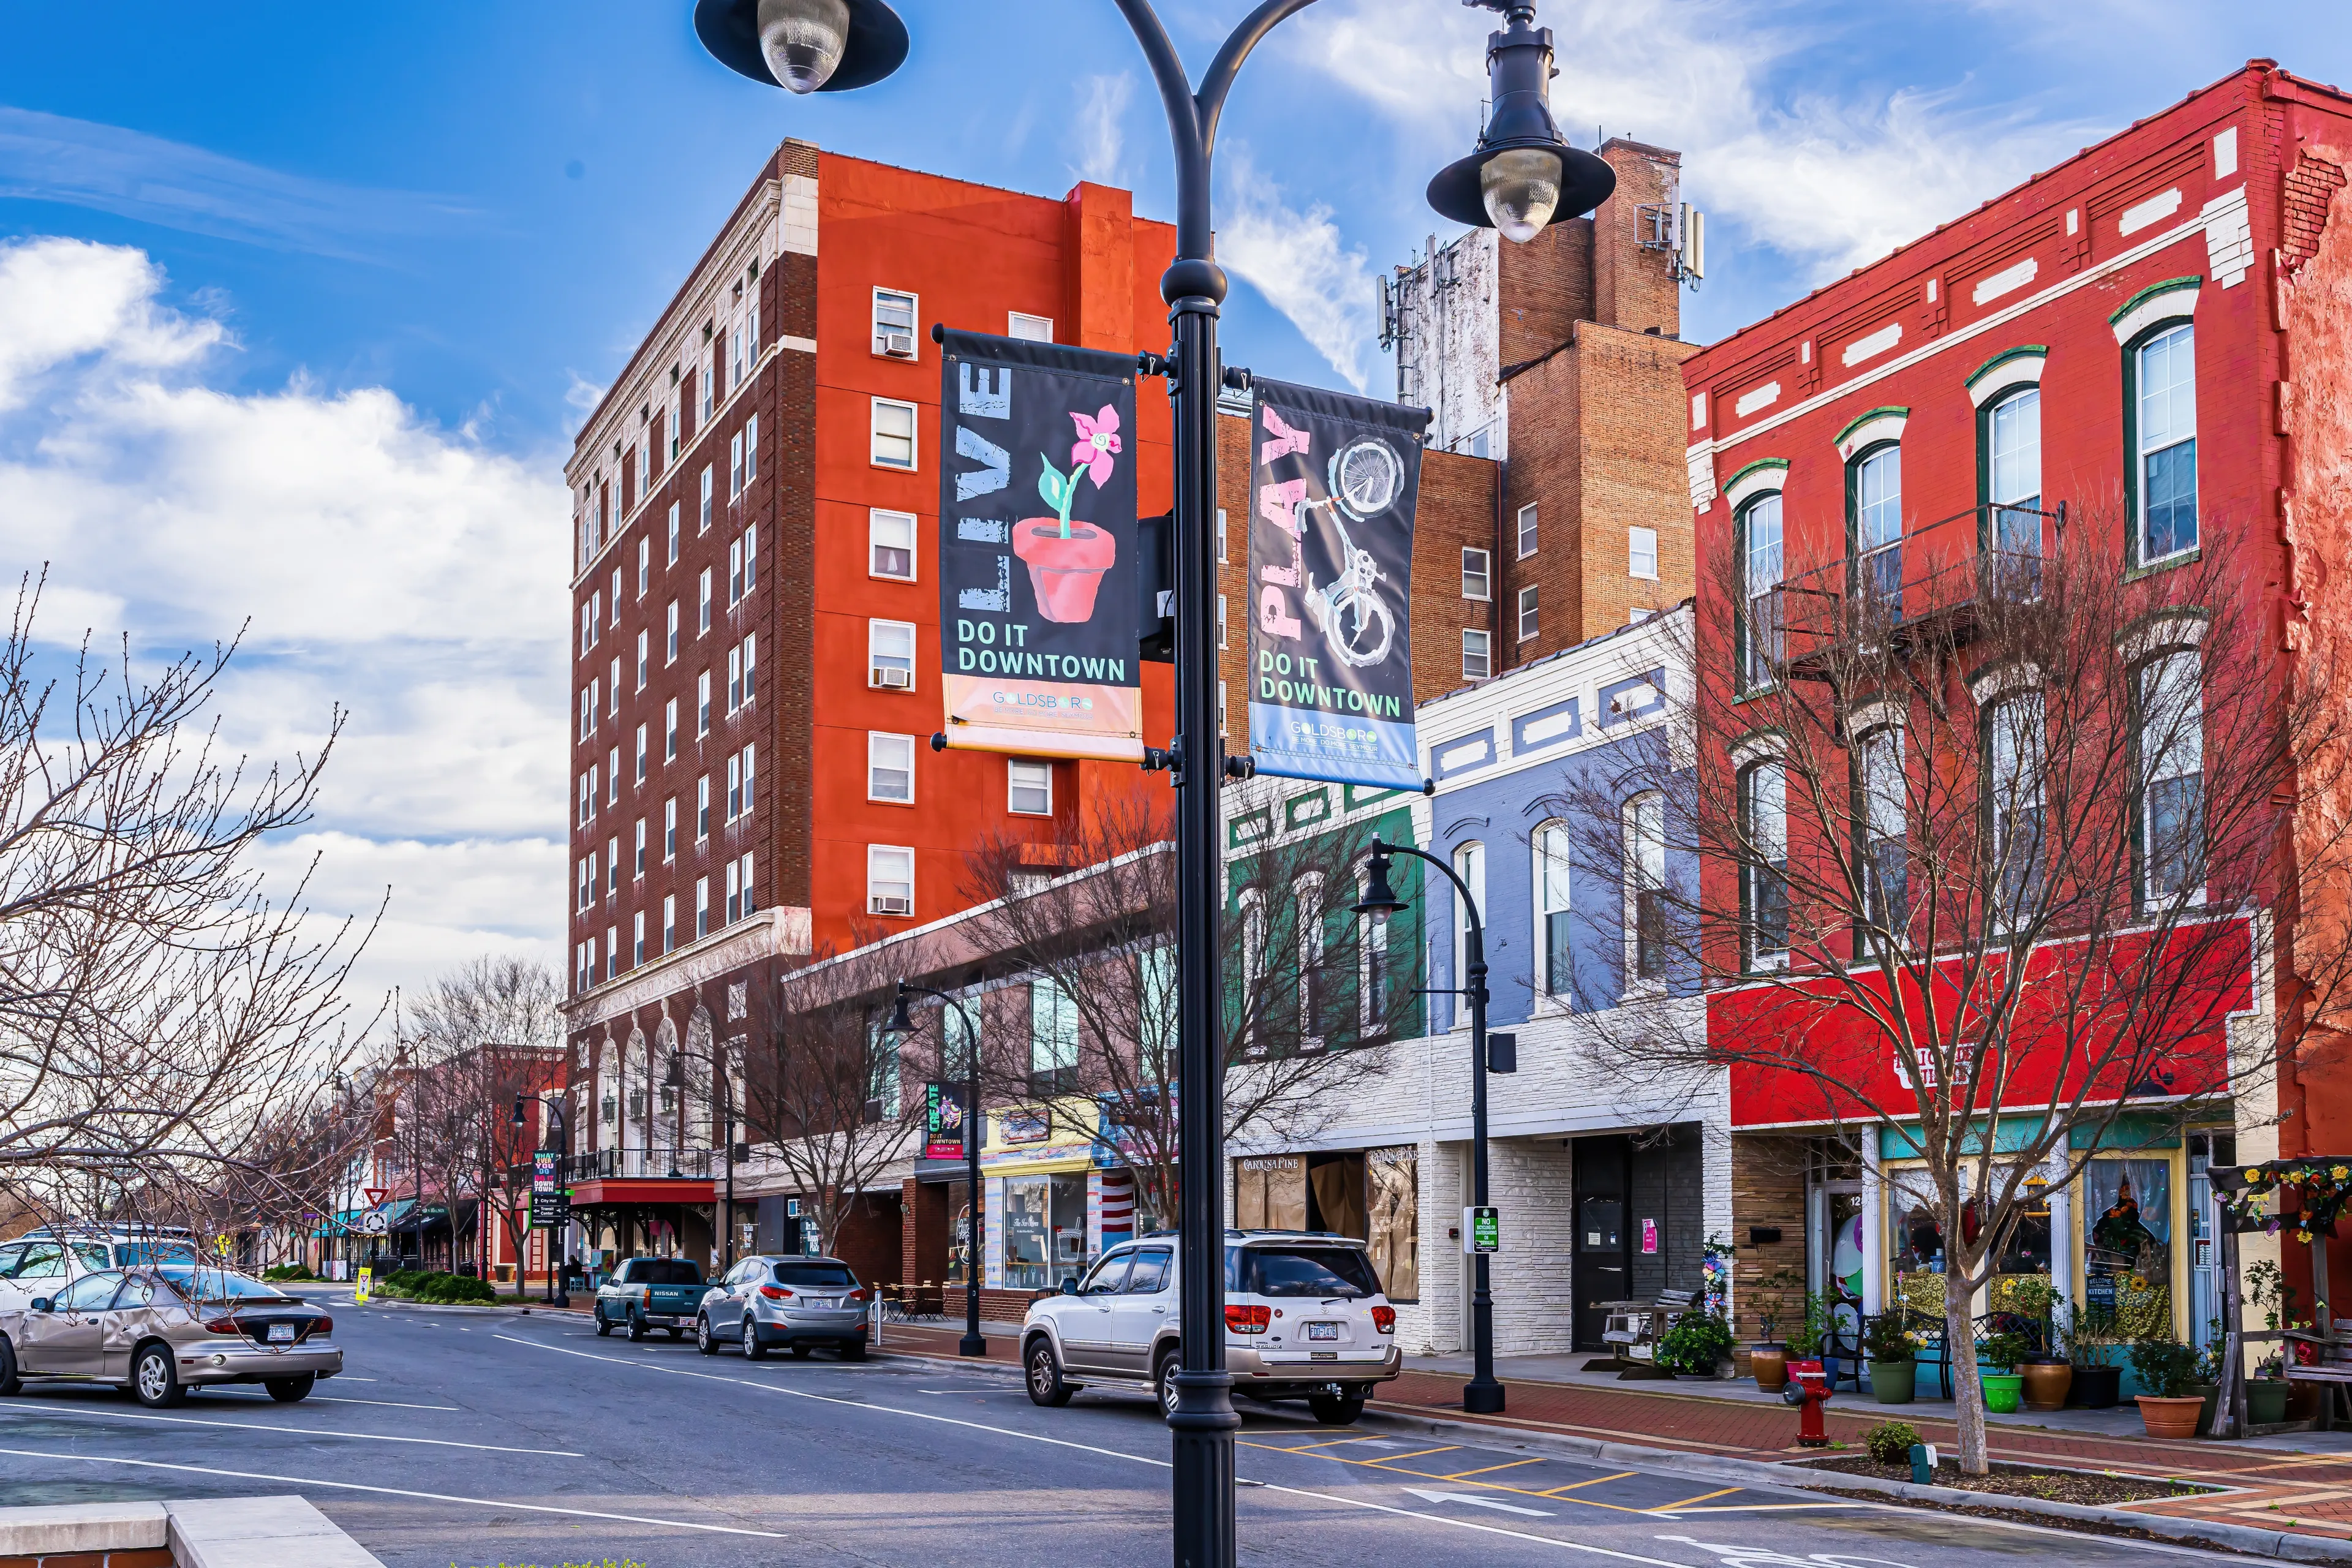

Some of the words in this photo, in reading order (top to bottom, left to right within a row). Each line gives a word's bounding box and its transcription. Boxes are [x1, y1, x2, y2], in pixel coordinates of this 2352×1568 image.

[956, 363, 1011, 612] LIVE
[1259, 404, 1310, 641] PLAY
[958, 619, 995, 644] DO
[1006, 624, 1028, 647] IT
[959, 647, 1125, 681] DOWNTOWN
[1260, 649, 1291, 675] DO
[1299, 656, 1318, 679] IT
[1261, 676, 1400, 717] DOWNTOWN
[929, 1084, 940, 1132] CREATE
[1244, 1159, 1277, 1171] CAROLINA
[1278, 1157, 1298, 1169] PINE
[1400, 1148, 1417, 1161] PINE
[1851, 1196, 1863, 1205] 12
